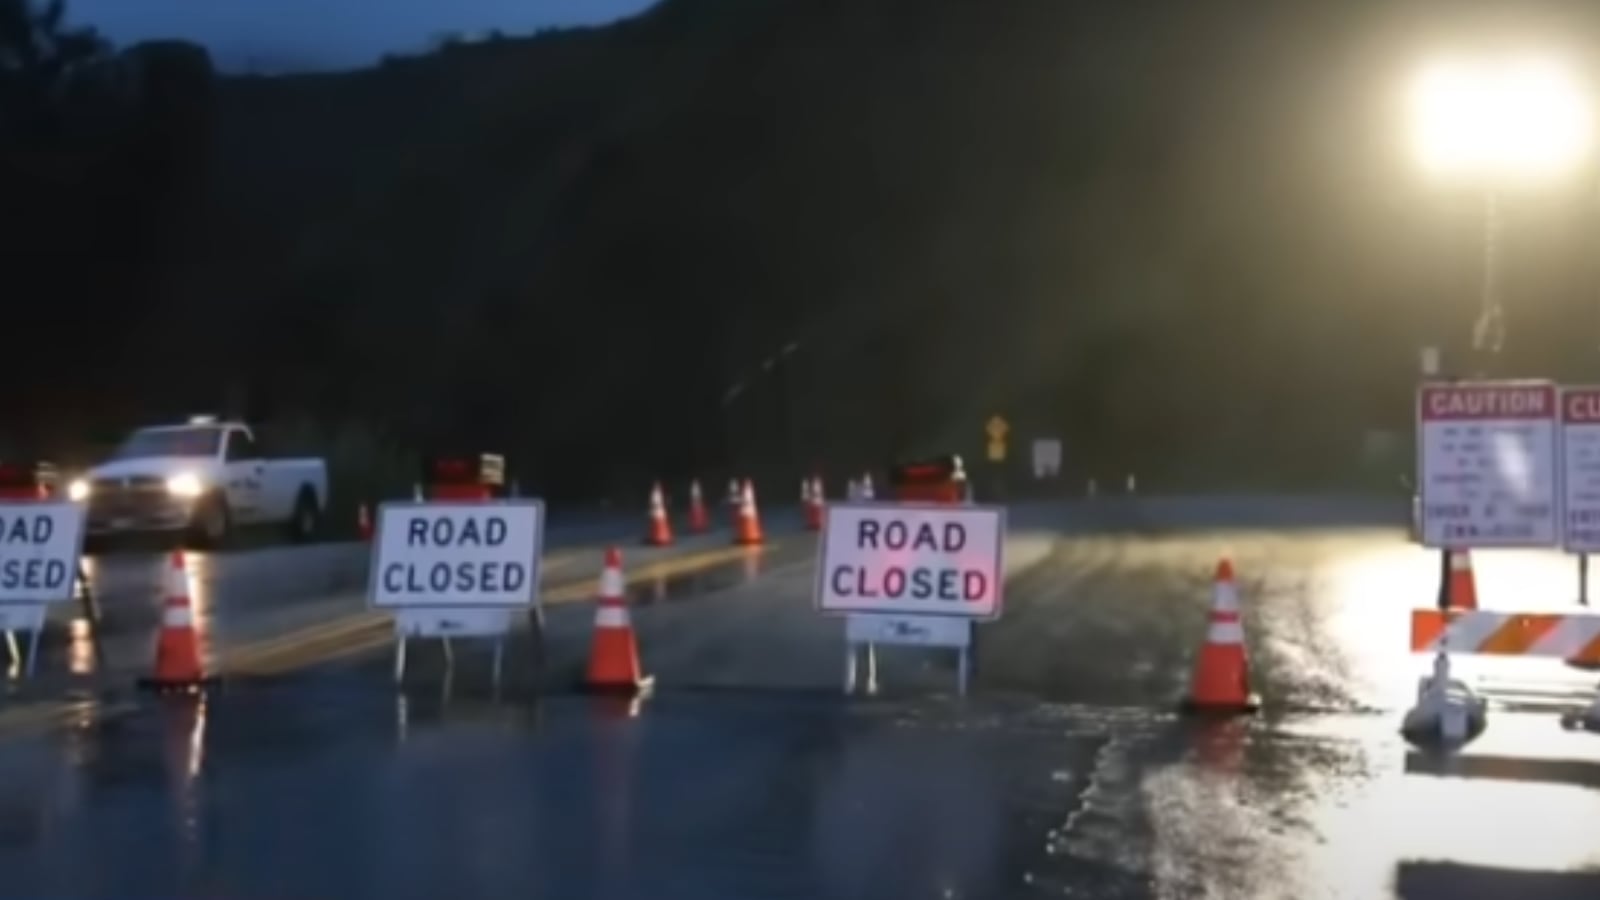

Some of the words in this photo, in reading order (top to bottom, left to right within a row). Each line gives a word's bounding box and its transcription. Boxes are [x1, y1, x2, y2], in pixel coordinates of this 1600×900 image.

[1430, 391, 1545, 416] CAUTION
[0, 514, 53, 543] AD
[408, 517, 507, 546] ROAD
[858, 520, 966, 552] ROAD
[3, 558, 66, 589] SED
[384, 562, 525, 593] CLOSED
[832, 565, 987, 602] CLOSED
